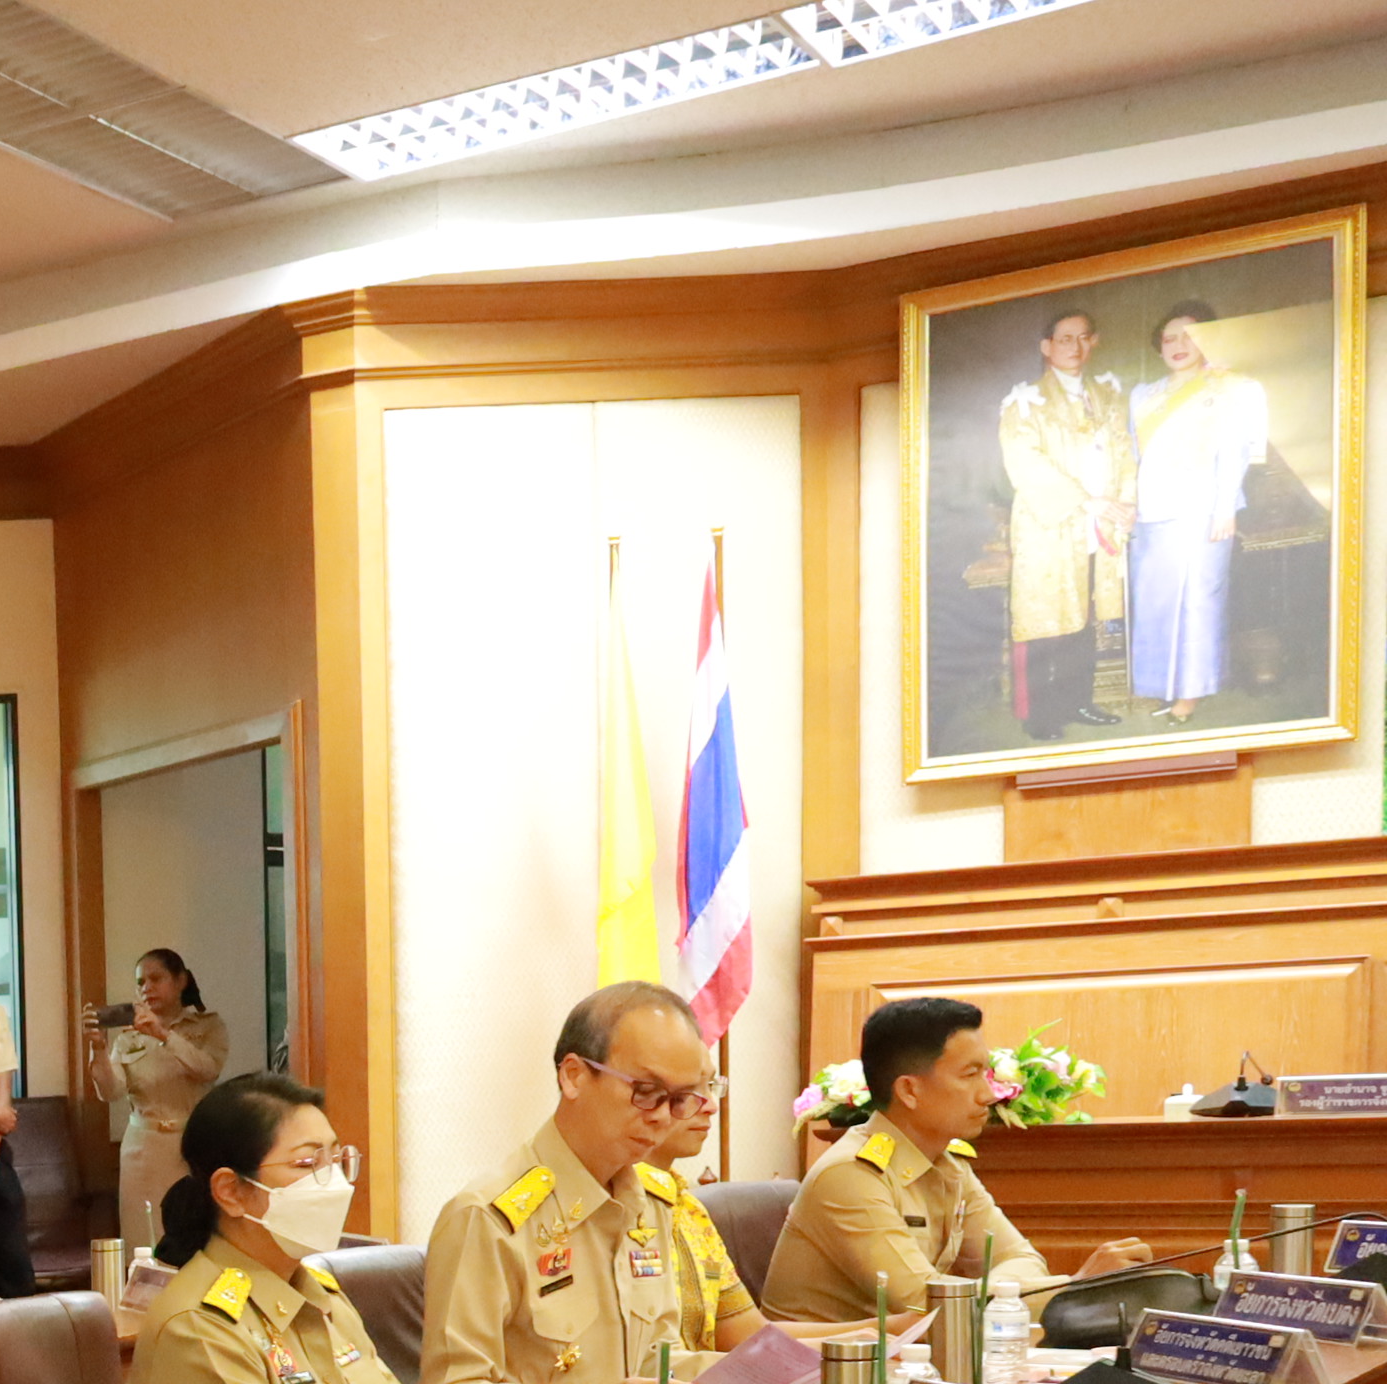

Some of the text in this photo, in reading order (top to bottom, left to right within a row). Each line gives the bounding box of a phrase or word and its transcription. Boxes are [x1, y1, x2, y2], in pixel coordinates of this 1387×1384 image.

[1236, 1283, 1358, 1325] อัยการจังหวัดเบตง
